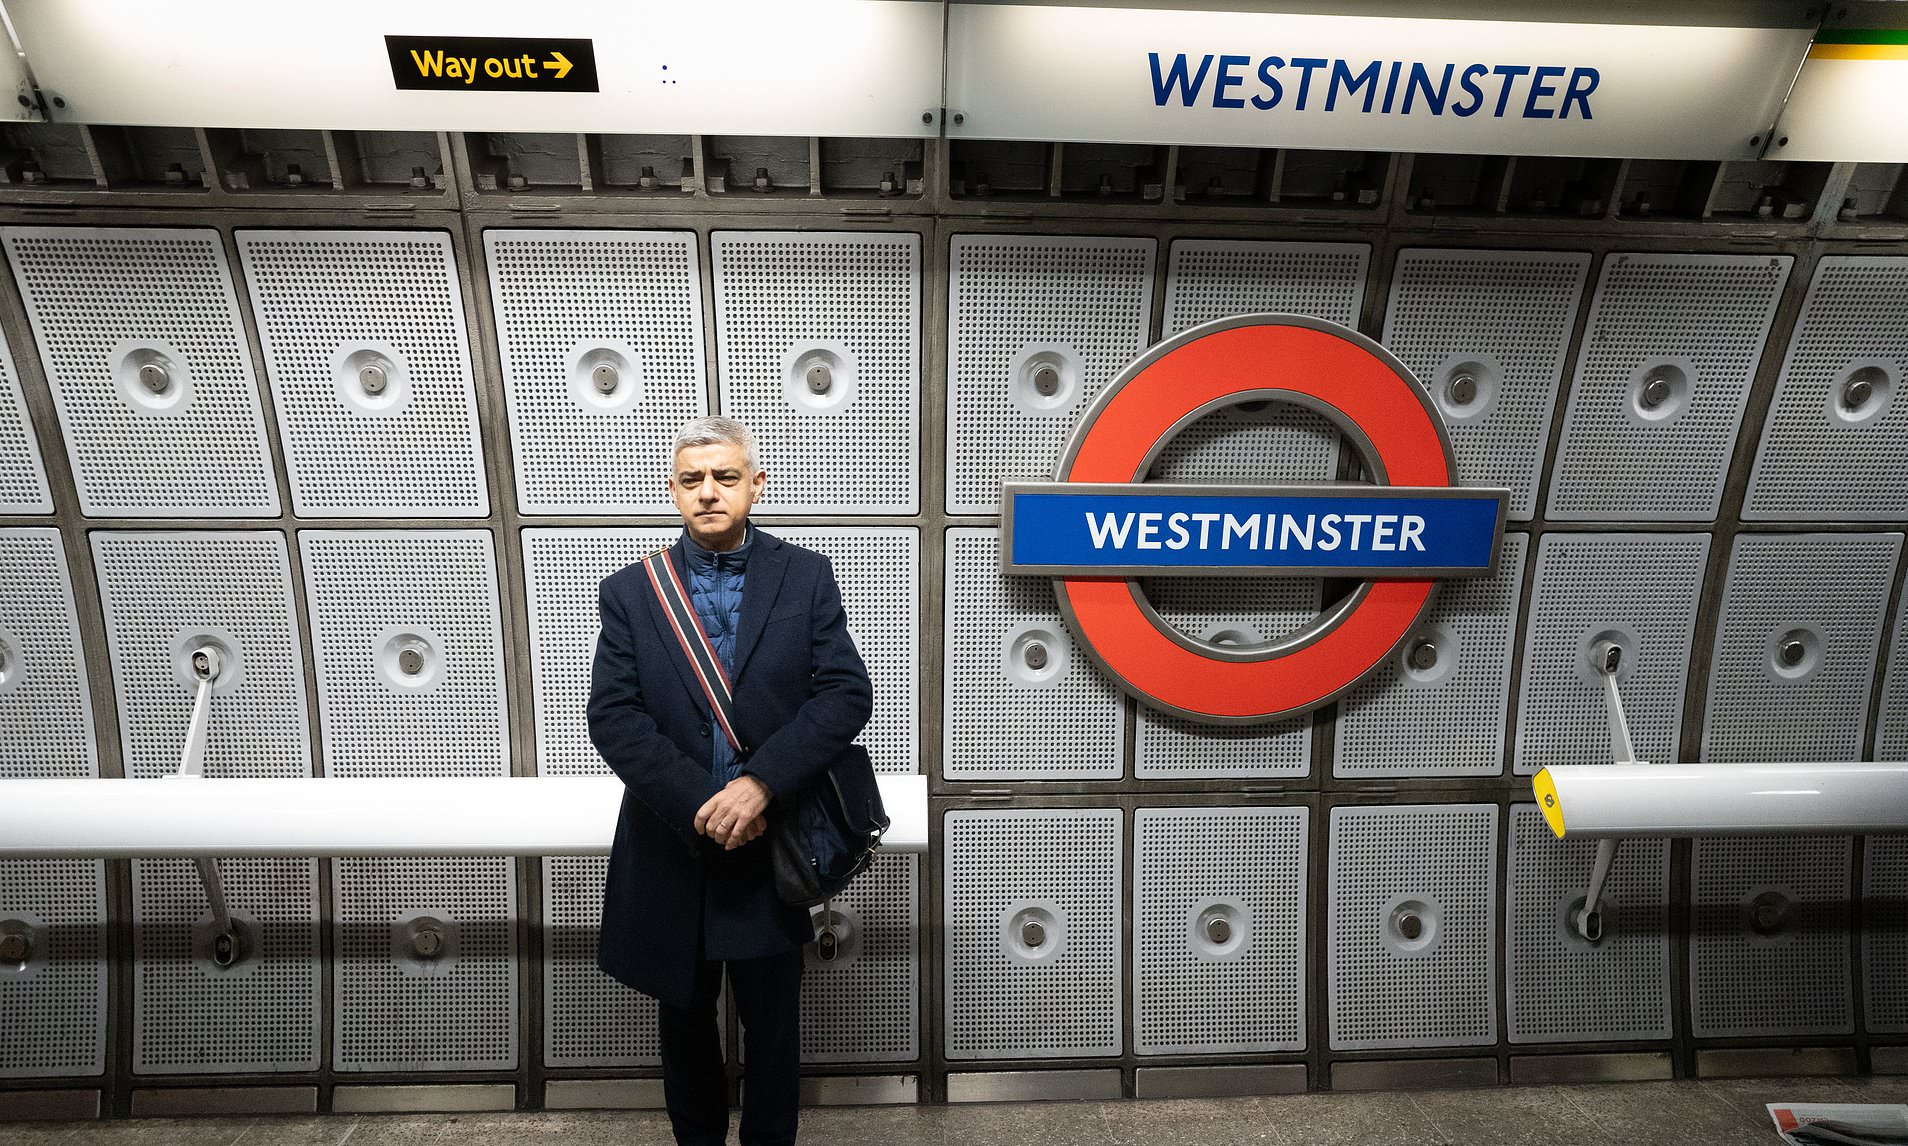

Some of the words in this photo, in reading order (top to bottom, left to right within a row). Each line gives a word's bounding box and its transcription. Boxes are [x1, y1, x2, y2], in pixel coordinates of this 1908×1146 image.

[411, 50, 476, 85] Way
[485, 54, 539, 79] out
[1148, 52, 1600, 119] WESTMINSTER
[1086, 511, 1426, 552] WESTMINSTER
